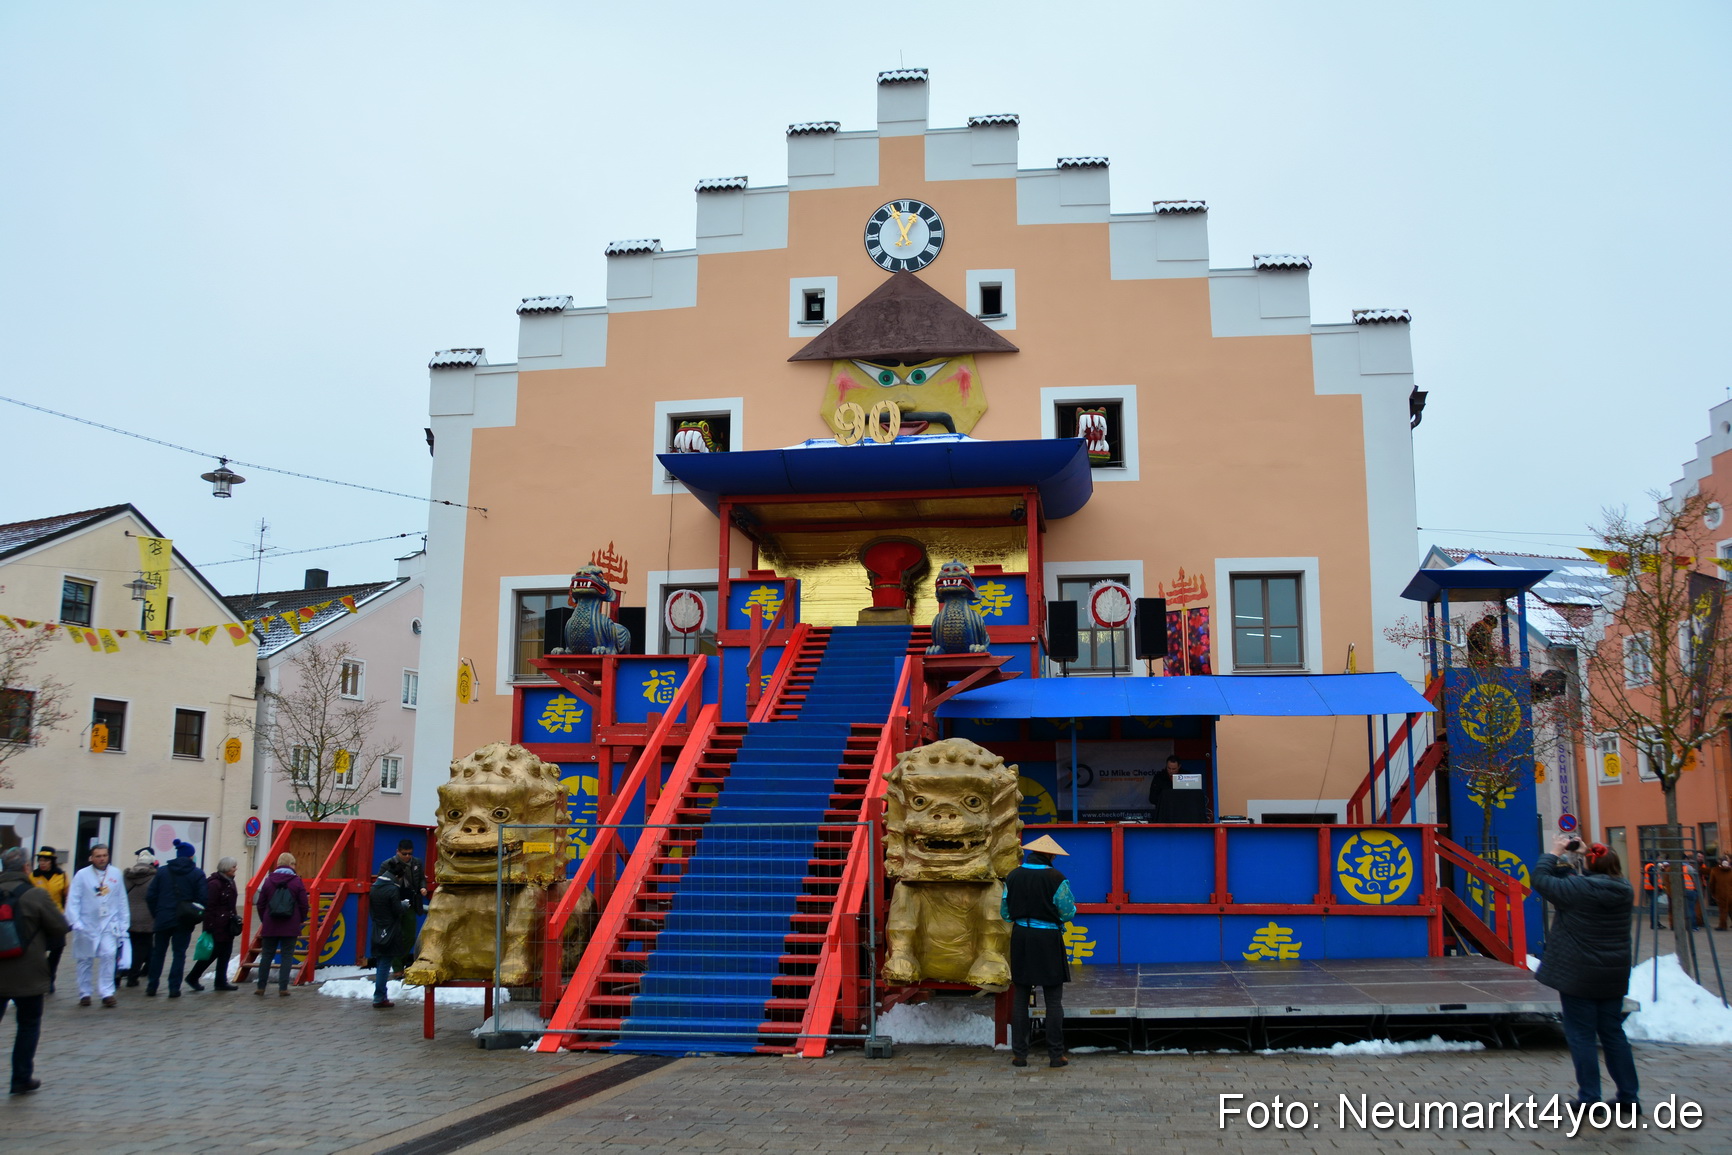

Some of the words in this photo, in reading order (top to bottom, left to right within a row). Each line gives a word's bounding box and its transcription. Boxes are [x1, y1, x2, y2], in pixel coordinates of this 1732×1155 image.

[833, 400, 901, 446] 90
[1099, 769, 1109, 777] DJ
[1111, 769, 1131, 777] Mike
[1558, 744, 1569, 814] SCHMUCK
